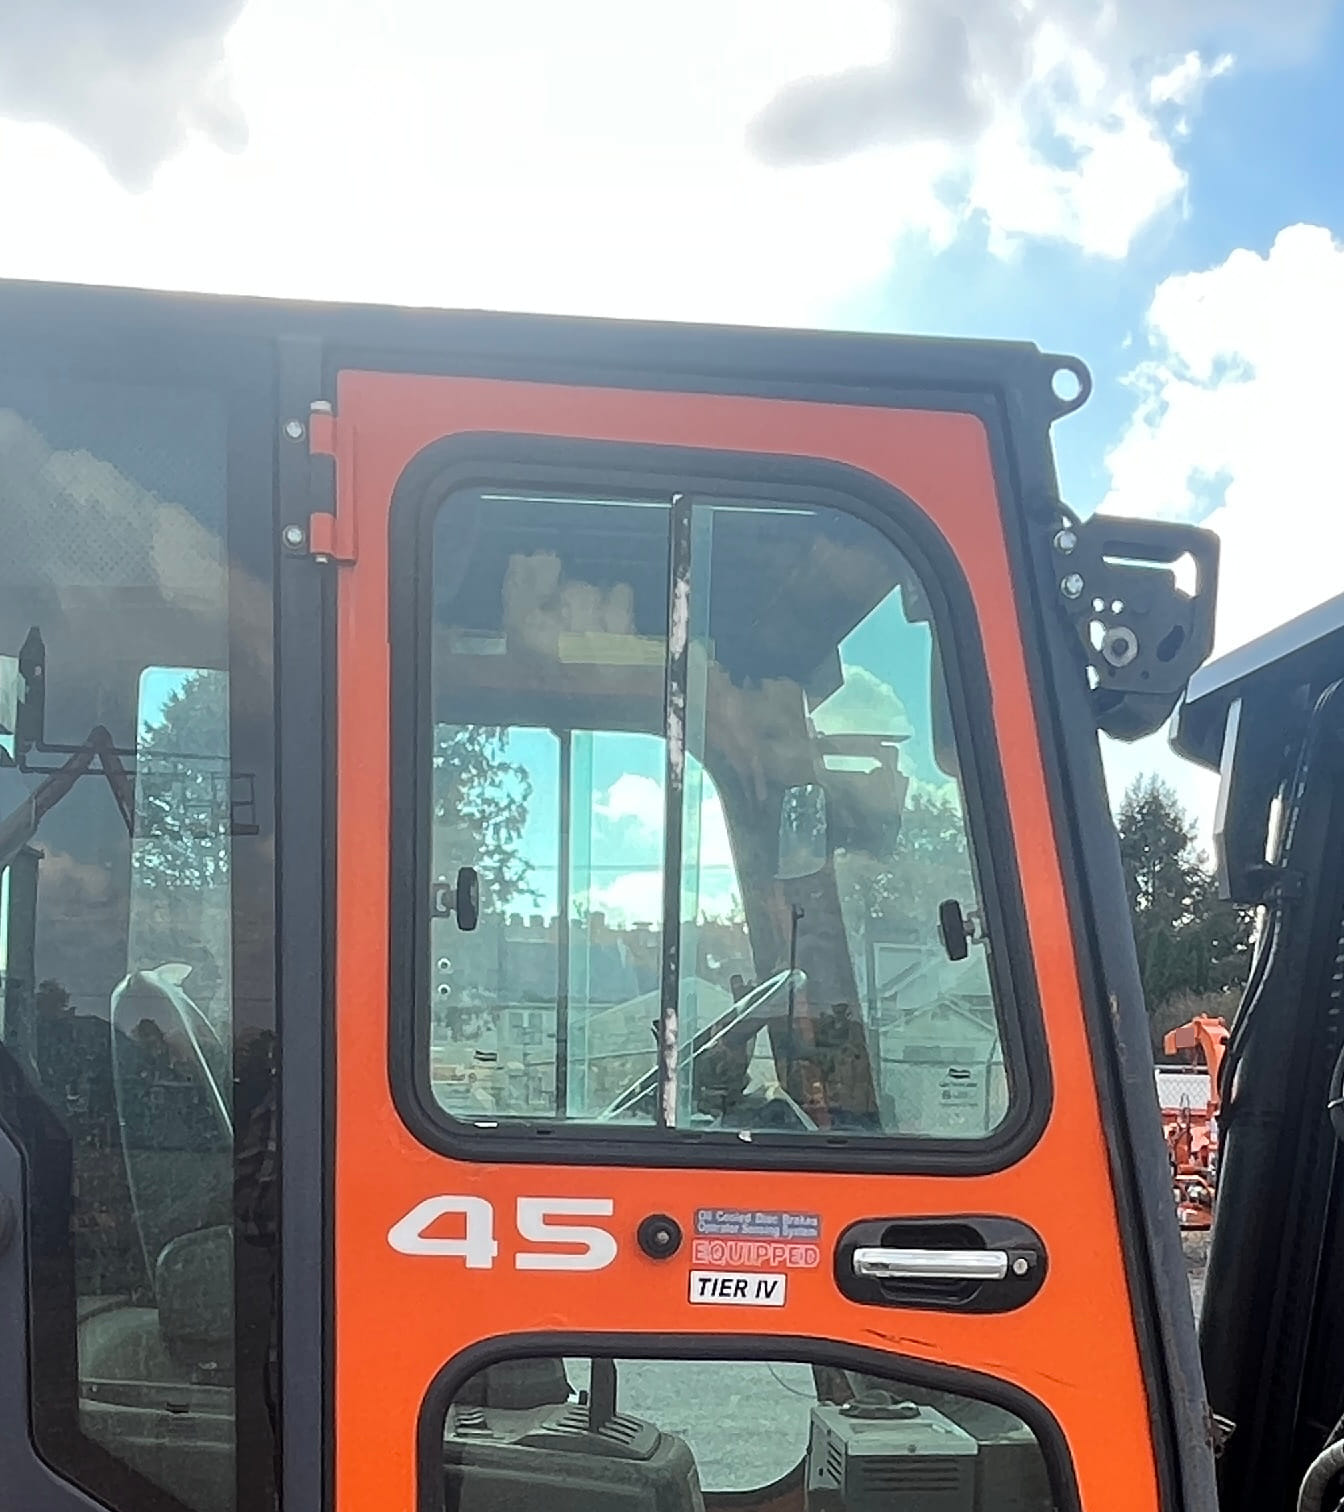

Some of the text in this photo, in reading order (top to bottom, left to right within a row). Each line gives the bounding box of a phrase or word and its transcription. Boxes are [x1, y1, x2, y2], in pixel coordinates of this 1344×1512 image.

[386, 1194, 618, 1271] 45
[692, 1240, 820, 1268] EQUIPPED
[698, 1277, 778, 1299] TIER IV
